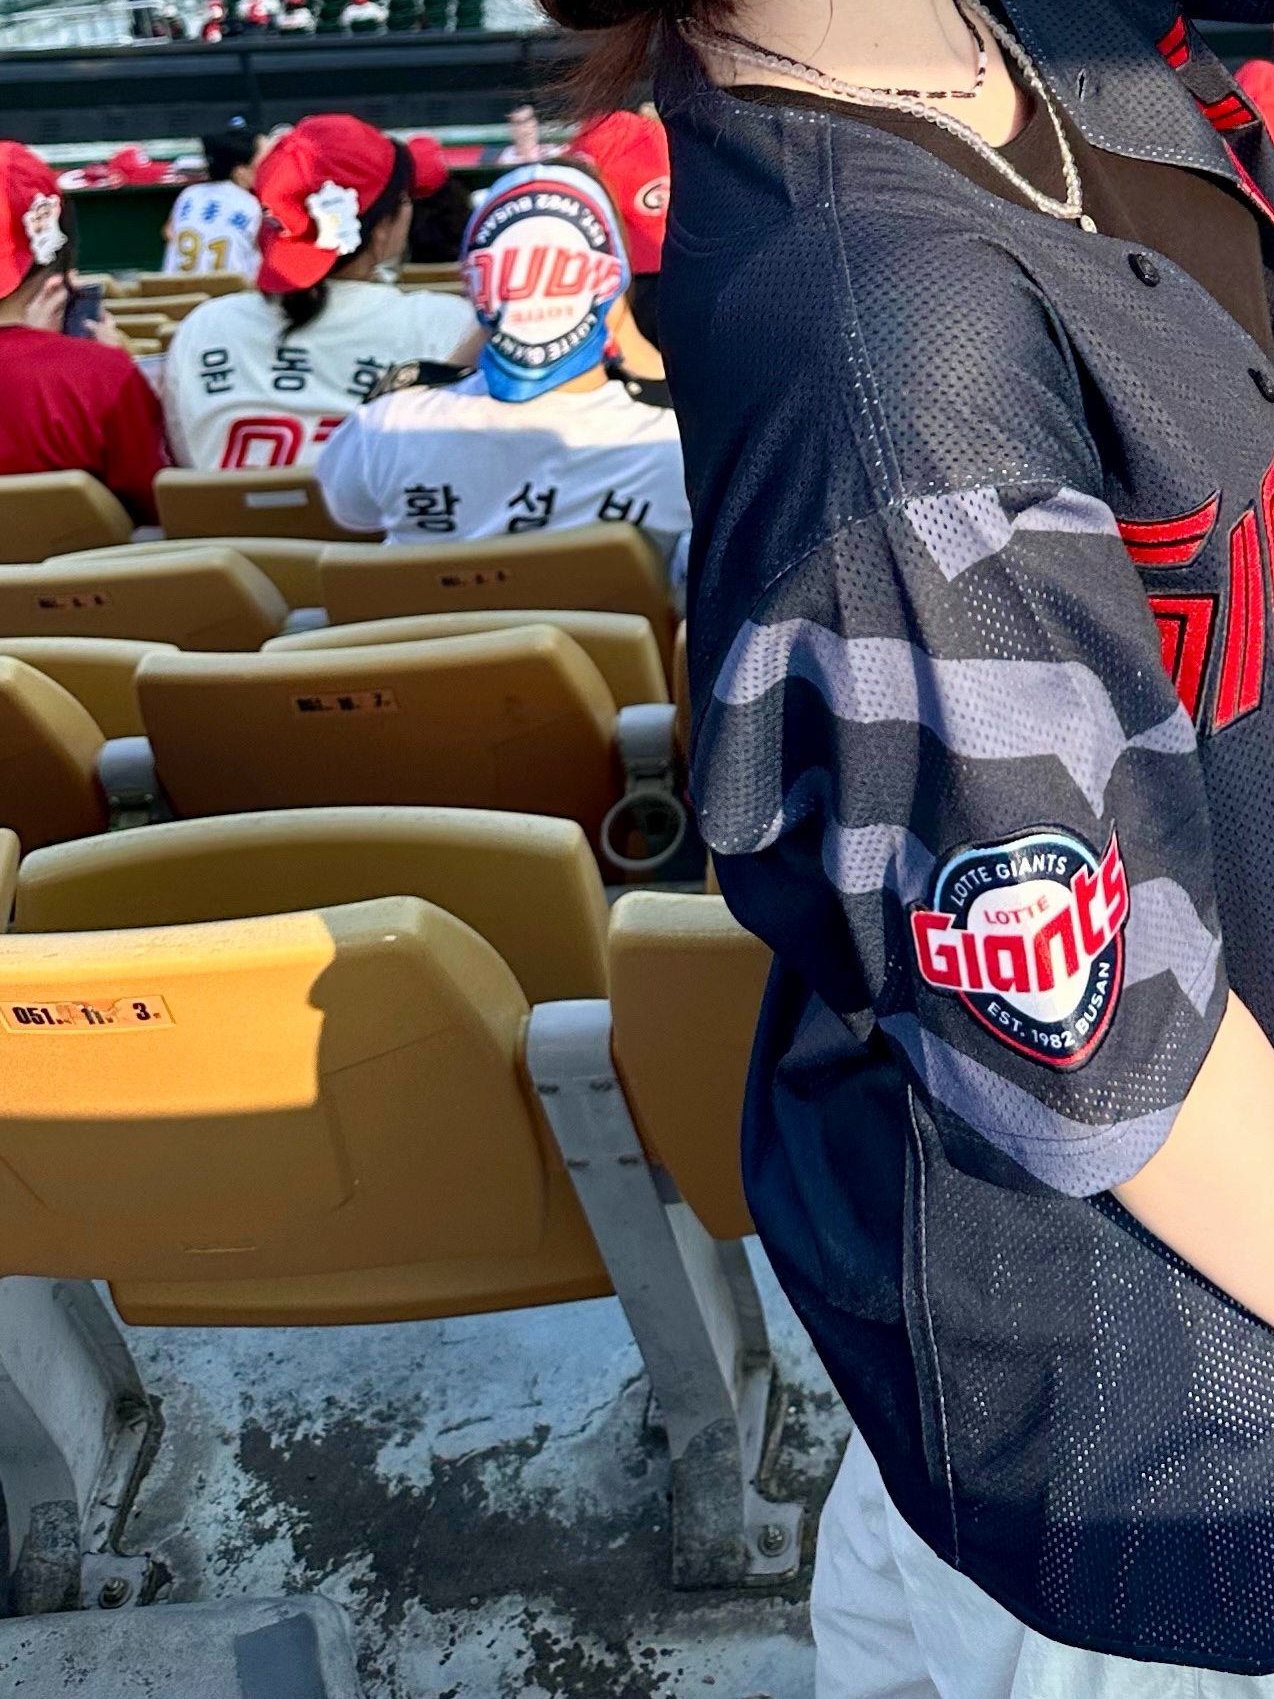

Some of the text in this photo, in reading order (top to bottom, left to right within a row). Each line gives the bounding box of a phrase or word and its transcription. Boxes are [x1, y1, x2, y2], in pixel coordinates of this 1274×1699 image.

[177, 230, 230, 272] 91
[951, 853, 1068, 907] LOTTE GIANTS
[983, 895, 1050, 925] LOTTE
[132, 1002, 152, 1021] 3
[987, 961, 1110, 1049] EST. 1982 BUSAN
